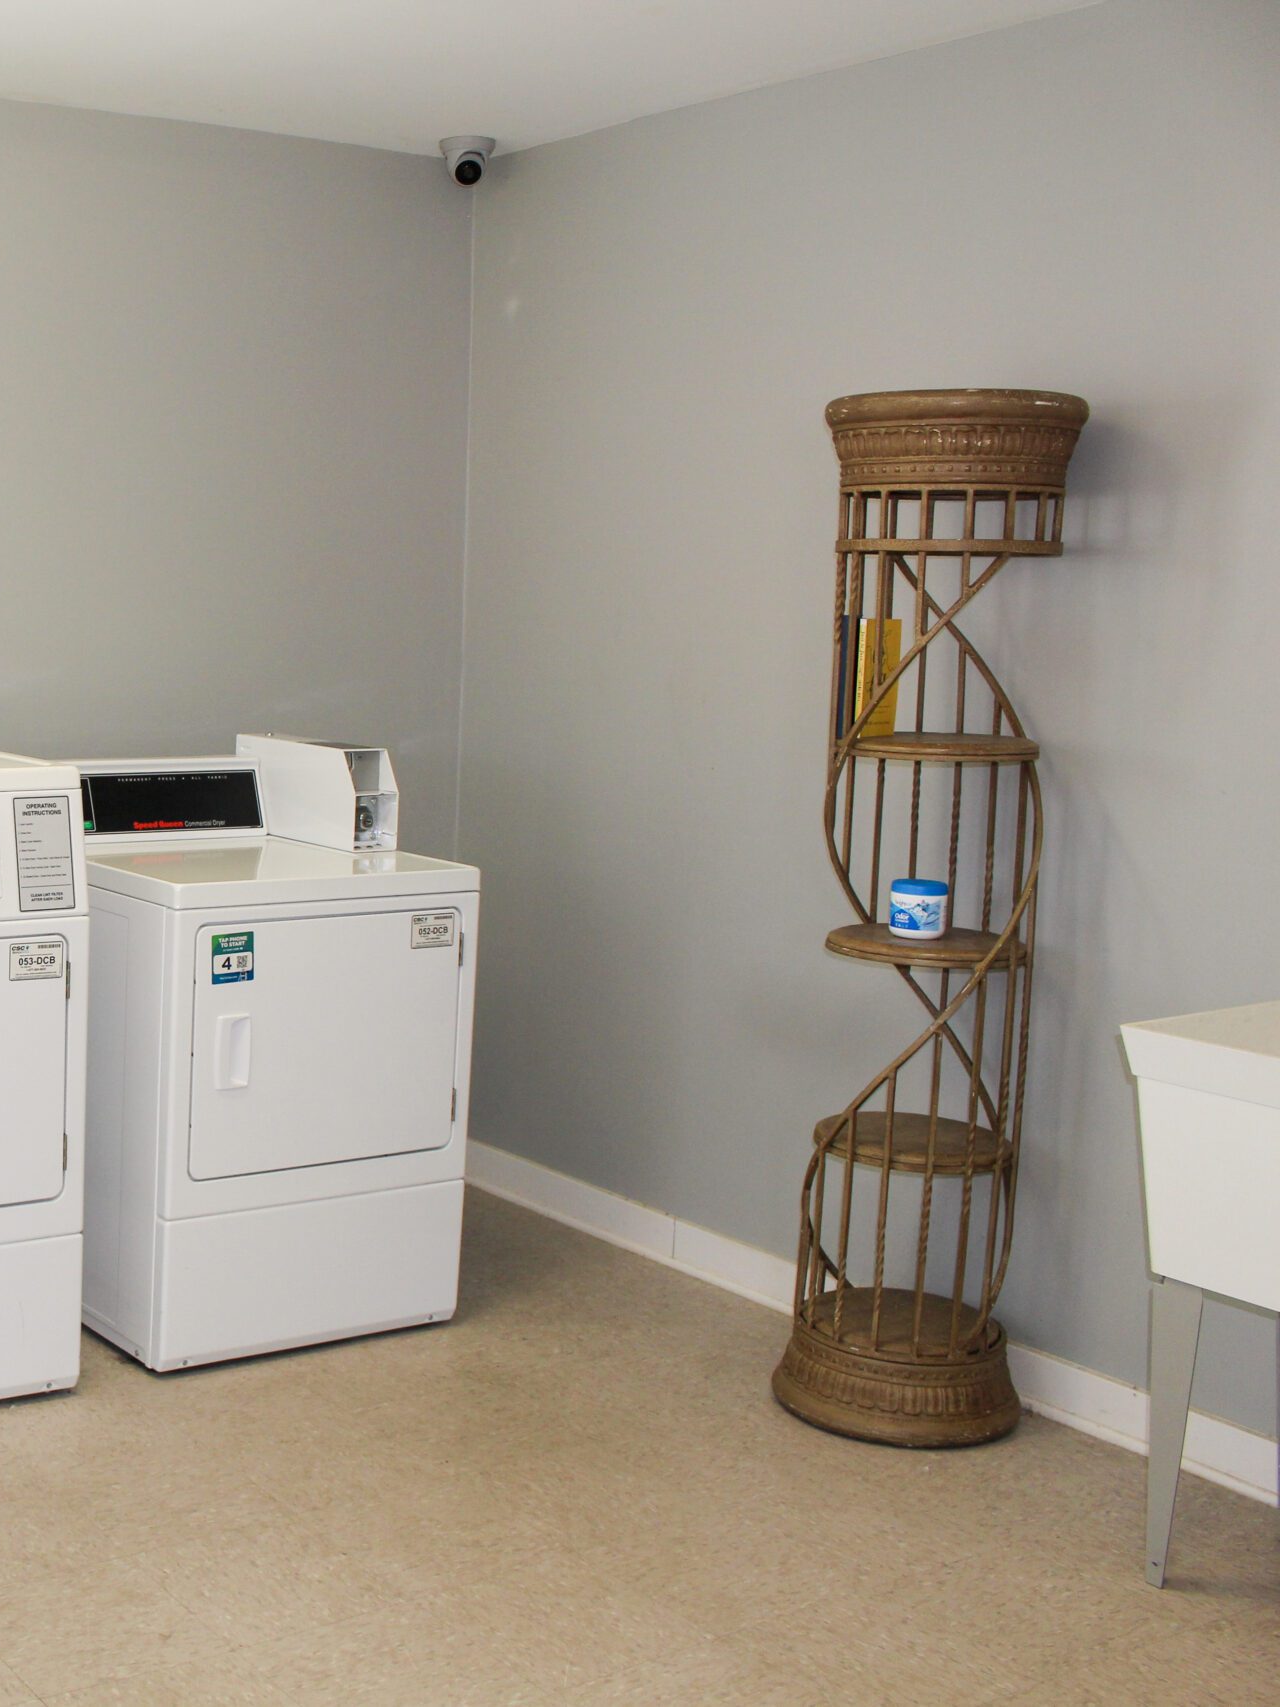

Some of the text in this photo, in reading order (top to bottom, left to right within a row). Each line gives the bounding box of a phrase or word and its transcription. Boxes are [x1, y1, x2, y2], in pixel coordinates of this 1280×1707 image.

[133, 819, 226, 830] Speed Queen Commercial Dryer
[18, 956, 56, 966] 053-DCB
[222, 957, 232, 970] 4
